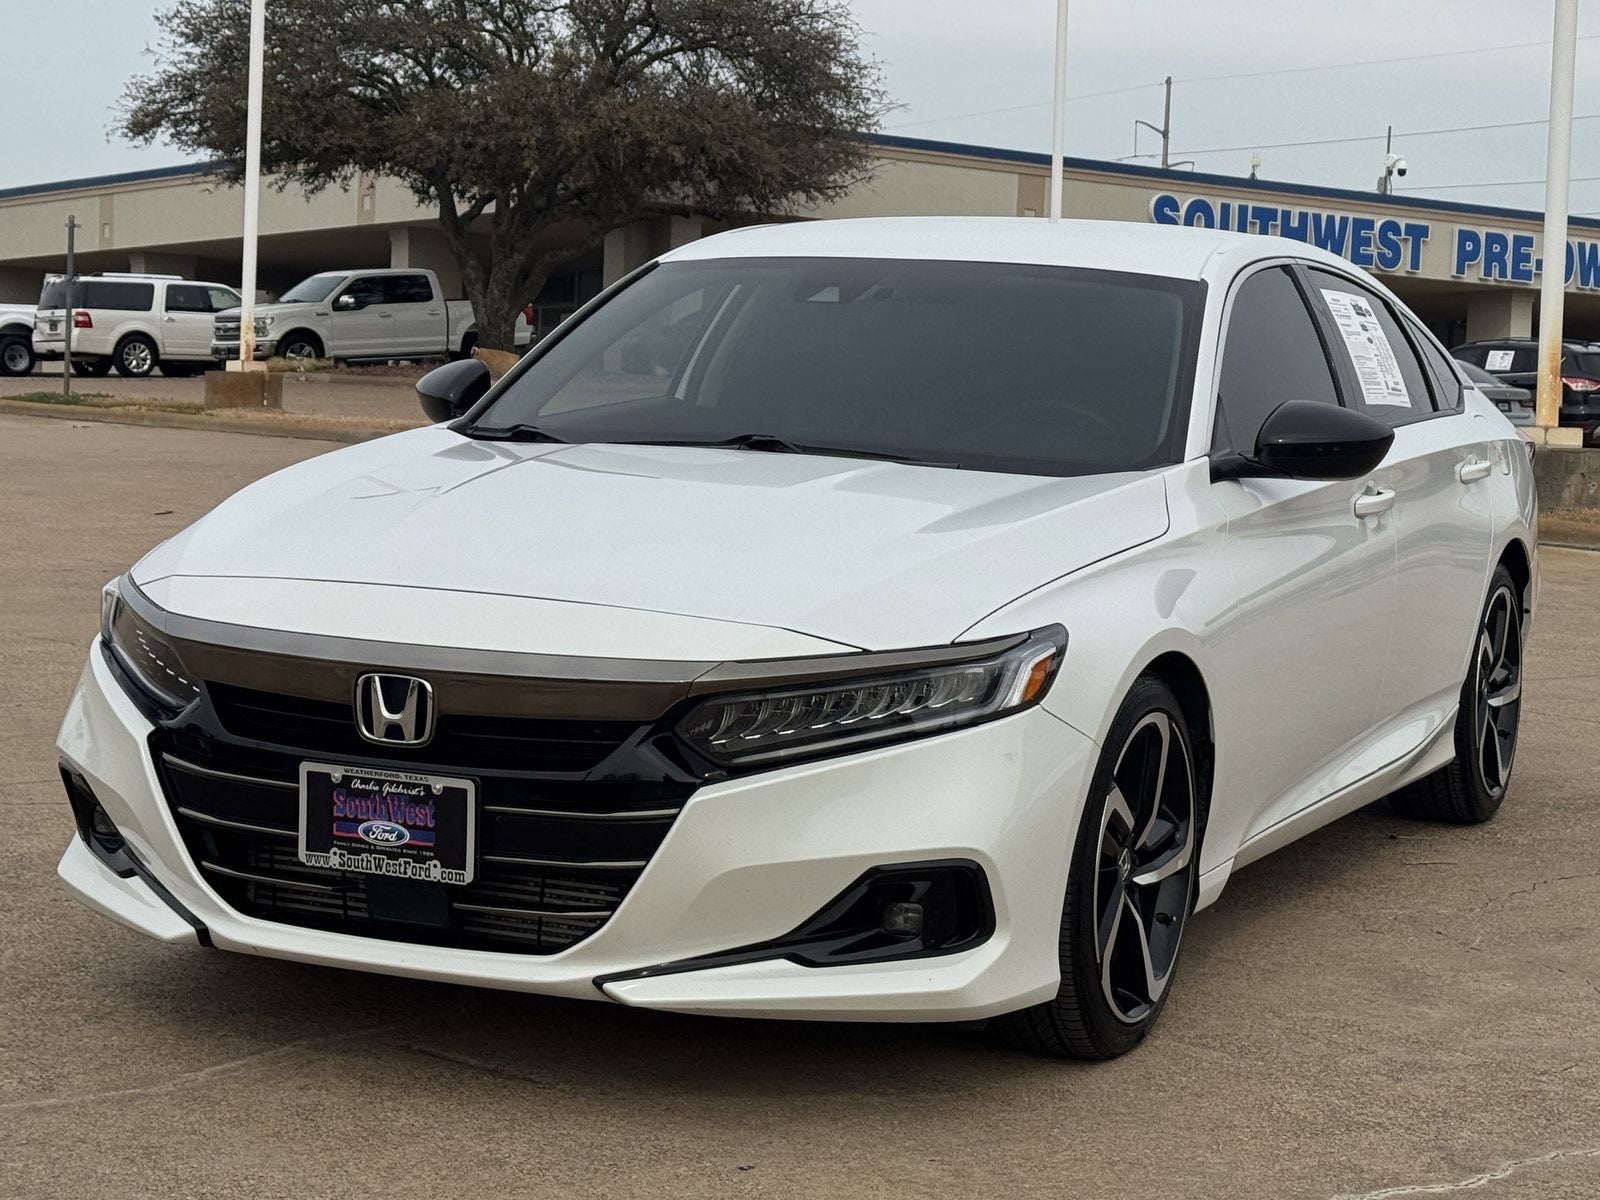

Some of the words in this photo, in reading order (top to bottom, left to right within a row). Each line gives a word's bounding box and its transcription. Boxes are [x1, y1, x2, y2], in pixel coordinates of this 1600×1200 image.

[343, 767, 403, 780] WEATHERFORD,
[404, 774, 429, 783] TEXAS
[351, 778, 380, 791] Charlie
[382, 782, 426, 797] Gilchrist's
[369, 824, 398, 842] Ford
